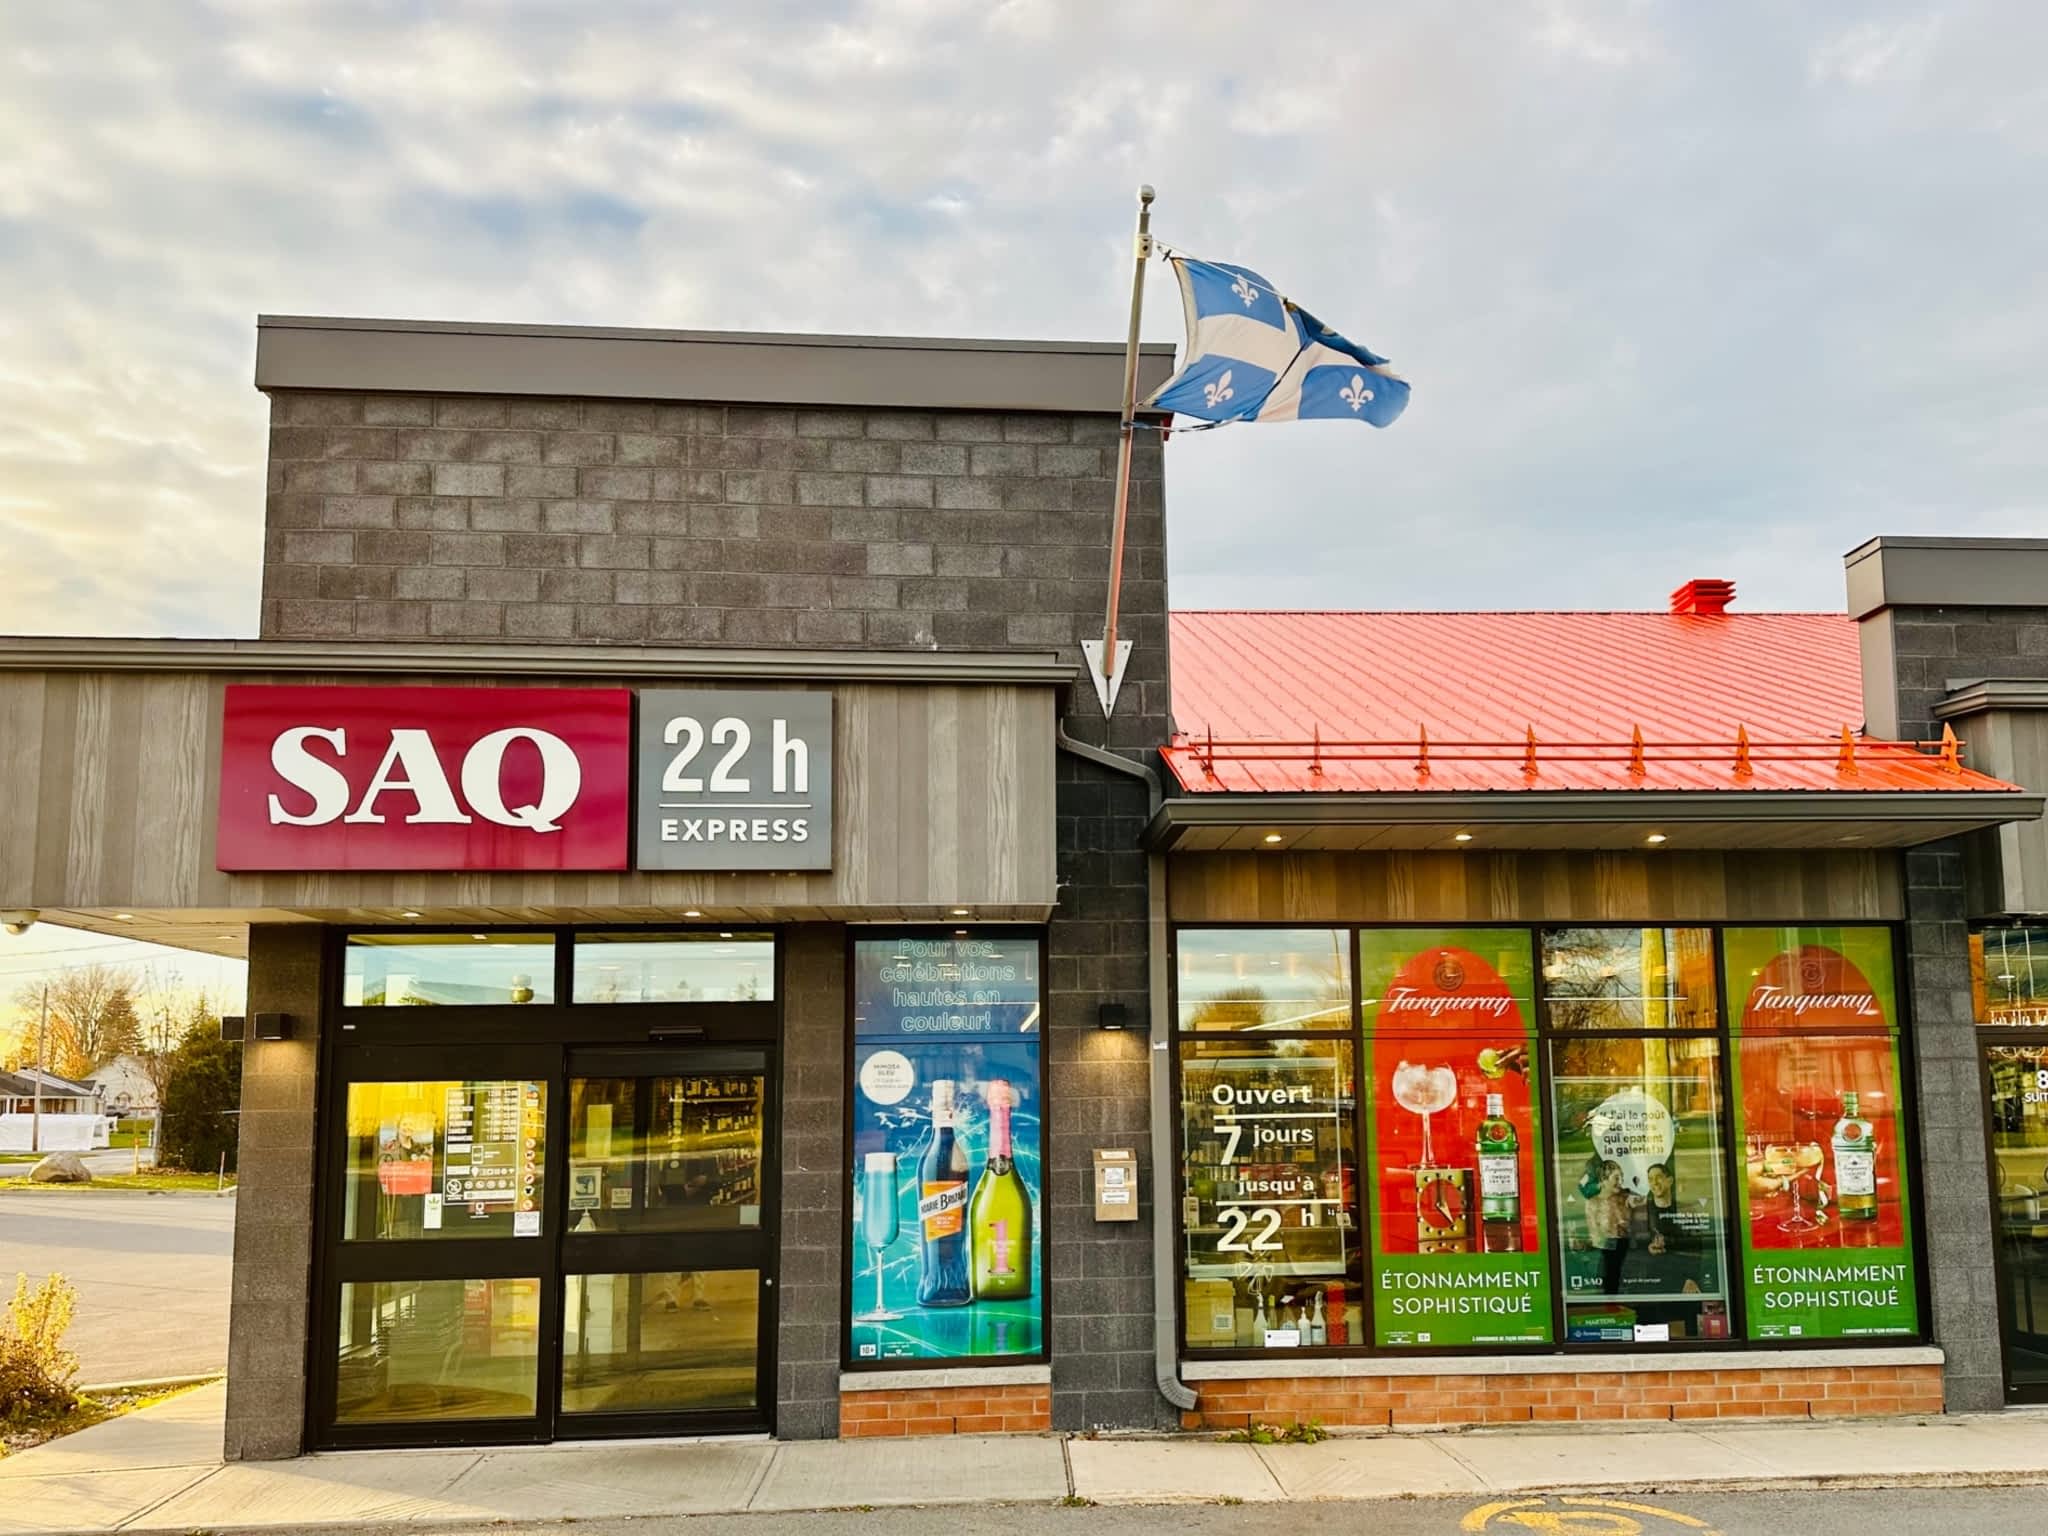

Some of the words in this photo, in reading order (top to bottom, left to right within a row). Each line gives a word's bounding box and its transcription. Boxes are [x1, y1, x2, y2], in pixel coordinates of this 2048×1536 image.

[661, 716, 752, 794] 22
[771, 718, 809, 794] h
[267, 725, 582, 833] SAQ
[660, 818, 809, 842] EXPRESS
[900, 939, 953, 958] Pour
[955, 941, 994, 958] vos
[879, 962, 1016, 984] célébrations
[893, 987, 968, 1007] hautes
[973, 989, 1001, 1006] en
[1387, 987, 1513, 1017] Tanqueray
[1753, 985, 1875, 1016] Tanqueray
[901, 1011, 992, 1032] couleur!
[2037, 1069, 2048, 1089] 8
[1212, 1083, 1312, 1105] Ouvert
[1213, 1125, 1242, 1166] 7
[1253, 1125, 1314, 1147] jours
[1238, 1175, 1315, 1195] jusqu'à
[1216, 1207, 1284, 1252] 22
[1301, 1207, 1316, 1227] h
[1381, 1269, 1541, 1290] ÉTONNAMMENT
[1754, 1263, 1907, 1285] ÉTONNAMMENT
[1392, 1292, 1533, 1315] SOPHISTIQUÉ
[1764, 1286, 1899, 1309] SOPHISTIQUÉ
